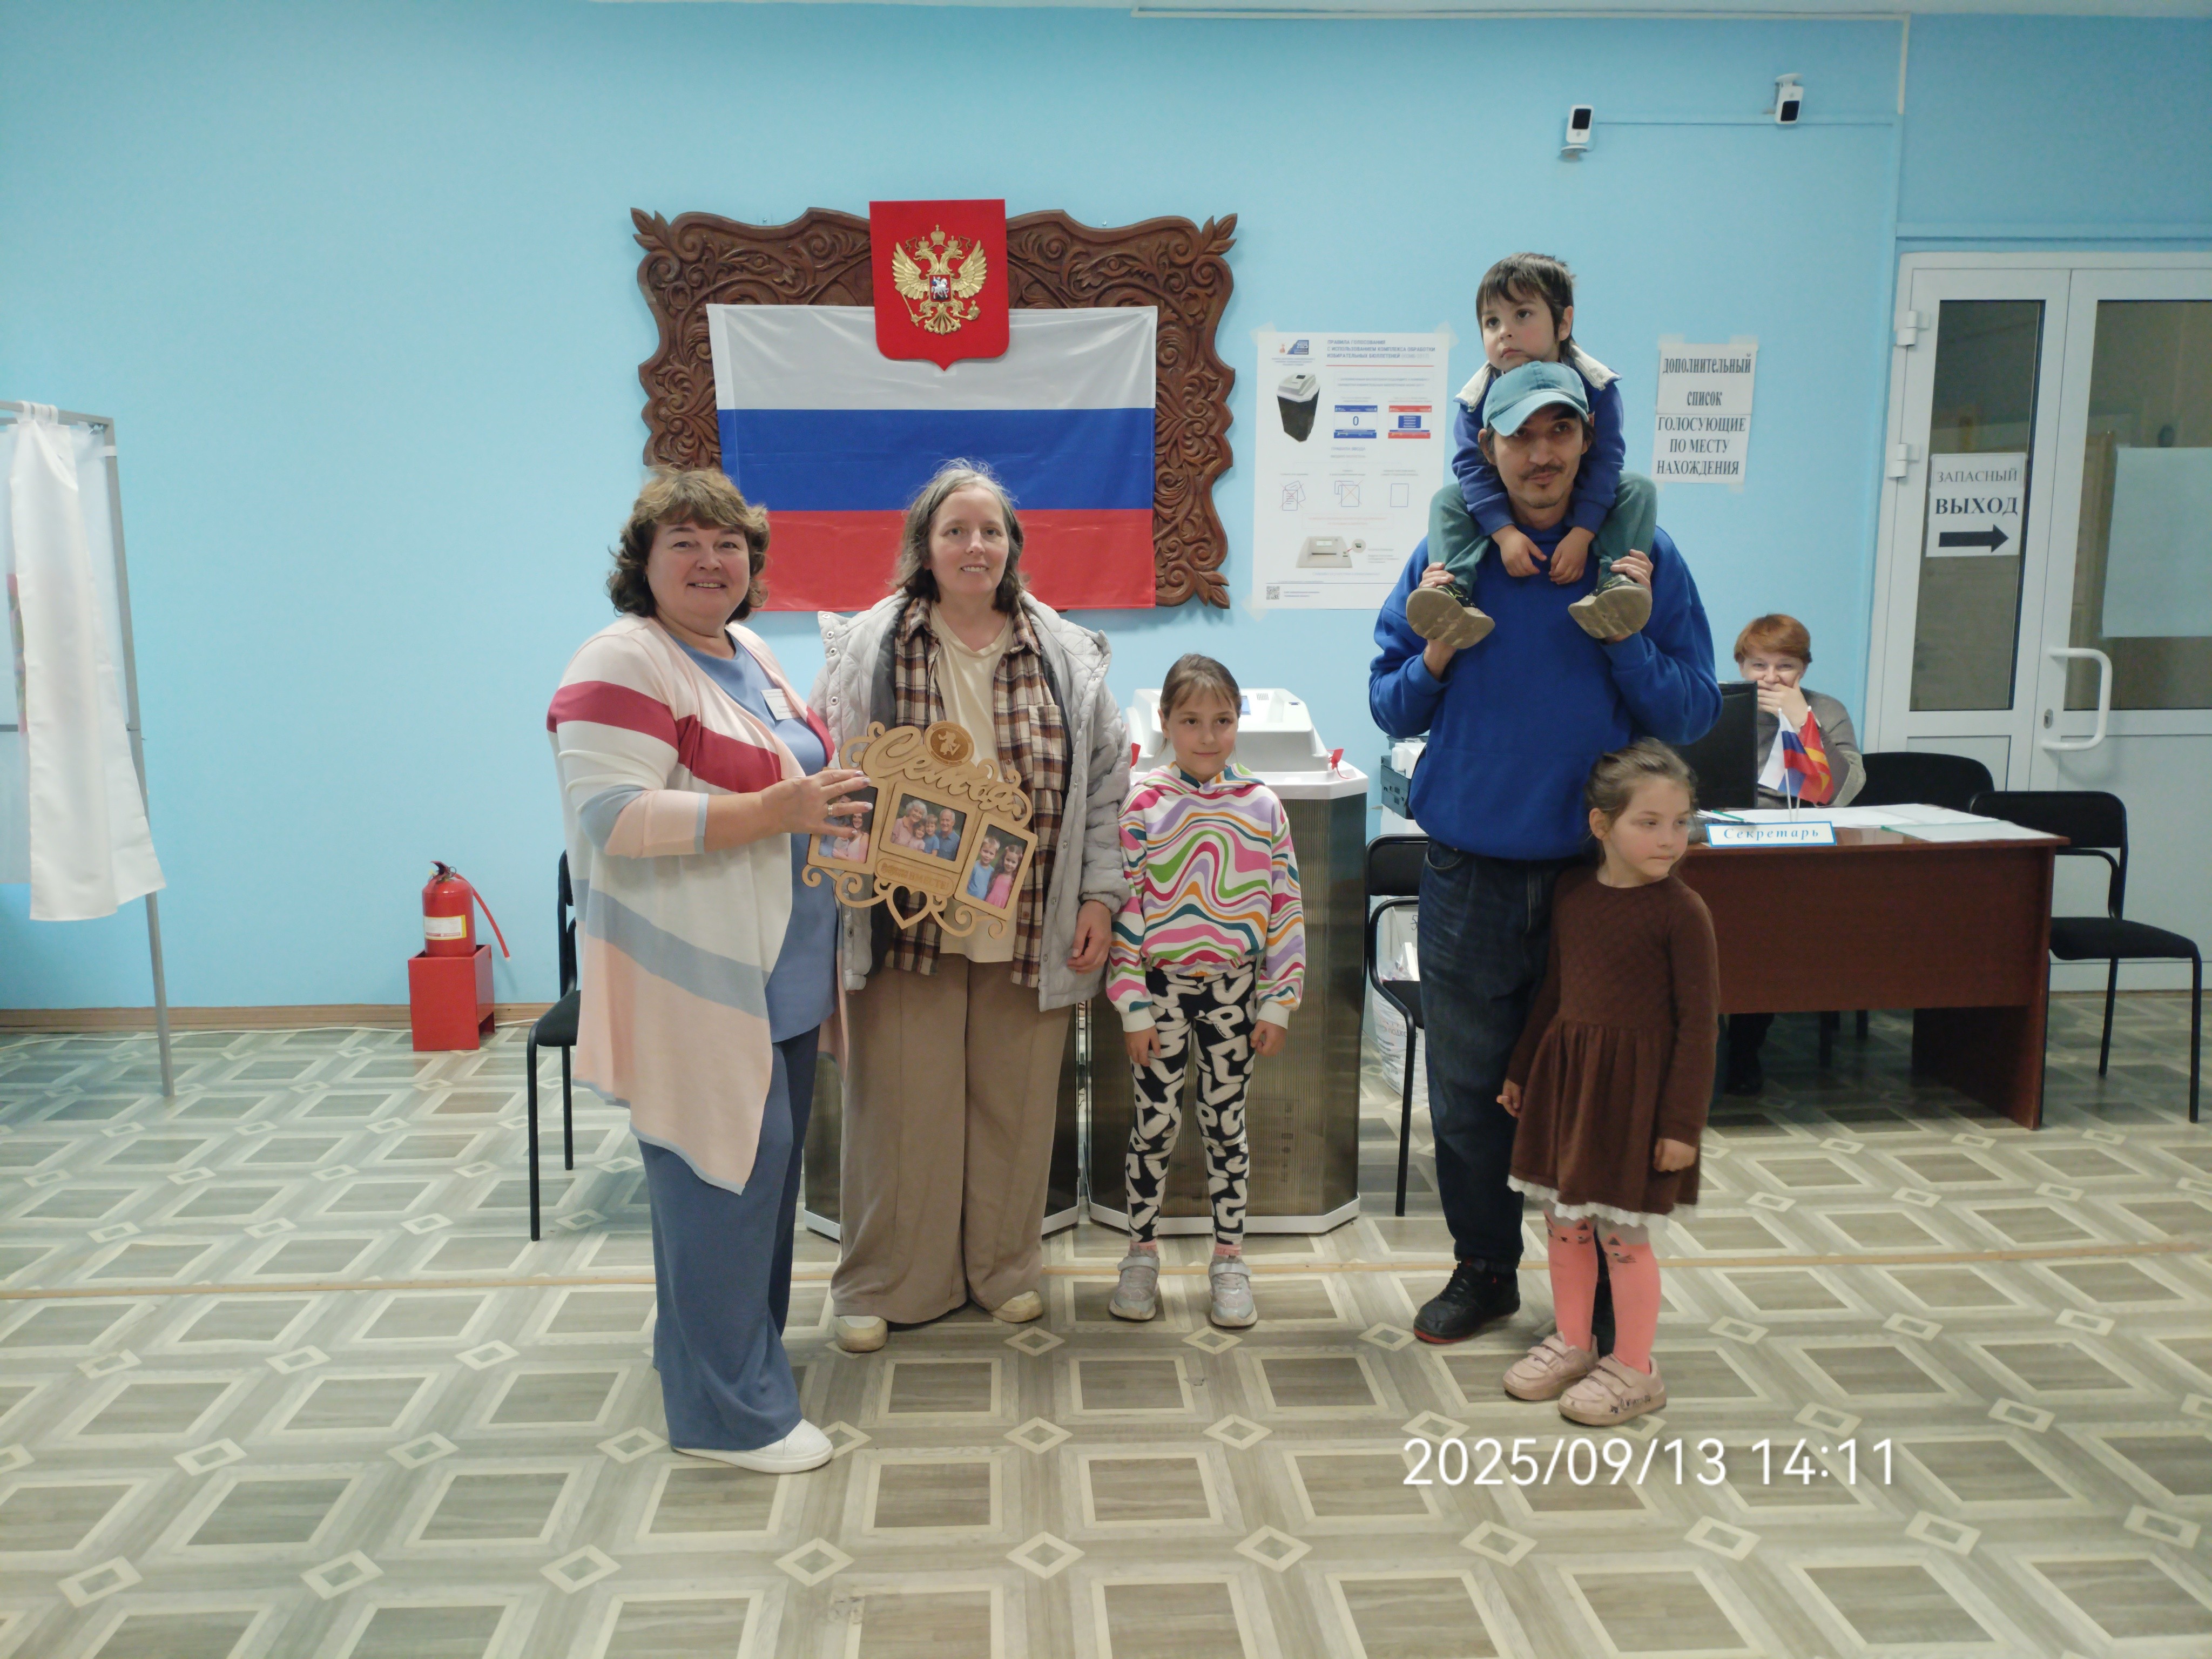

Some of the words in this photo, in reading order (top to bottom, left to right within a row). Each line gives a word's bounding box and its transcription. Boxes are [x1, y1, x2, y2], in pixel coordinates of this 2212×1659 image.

[1658, 417, 1746, 433] ГОЛОСУЮЩИЕ
[1669, 439, 1686, 453] ПО
[1690, 439, 1730, 453] МЕСТУ
[1656, 460, 1739, 476] НАХОЖДЕНИЯ
[1938, 468, 2017, 483] ЗАПАСНЫЙ
[1936, 497, 2018, 516] ВЫХОД
[1723, 827, 1819, 841] Секретарь
